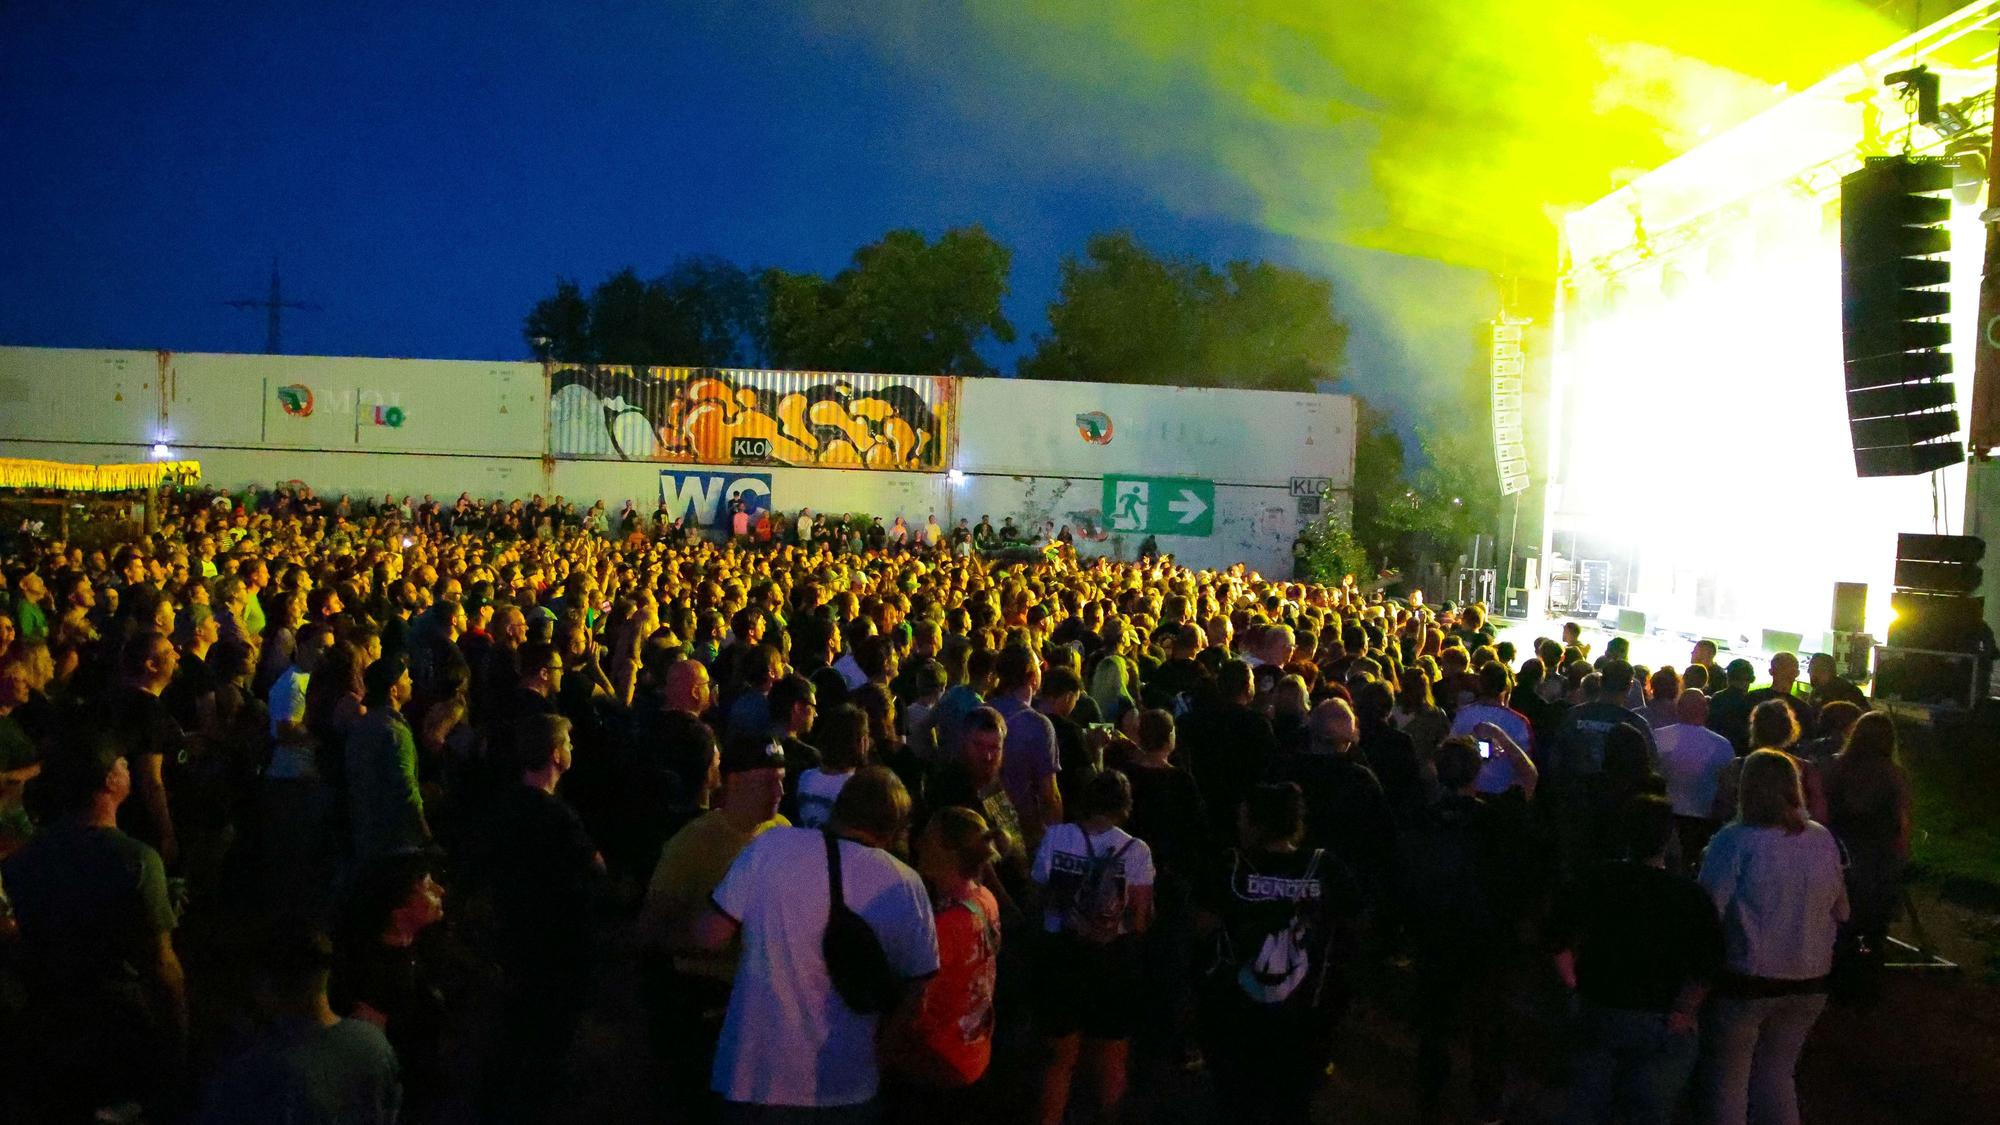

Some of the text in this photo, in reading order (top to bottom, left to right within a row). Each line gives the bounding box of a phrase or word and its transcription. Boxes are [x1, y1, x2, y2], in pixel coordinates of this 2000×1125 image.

[362, 405, 402, 427] LO
[734, 439, 764, 456] KLO
[661, 475, 771, 525] WC
[1053, 854, 1125, 876] DONS
